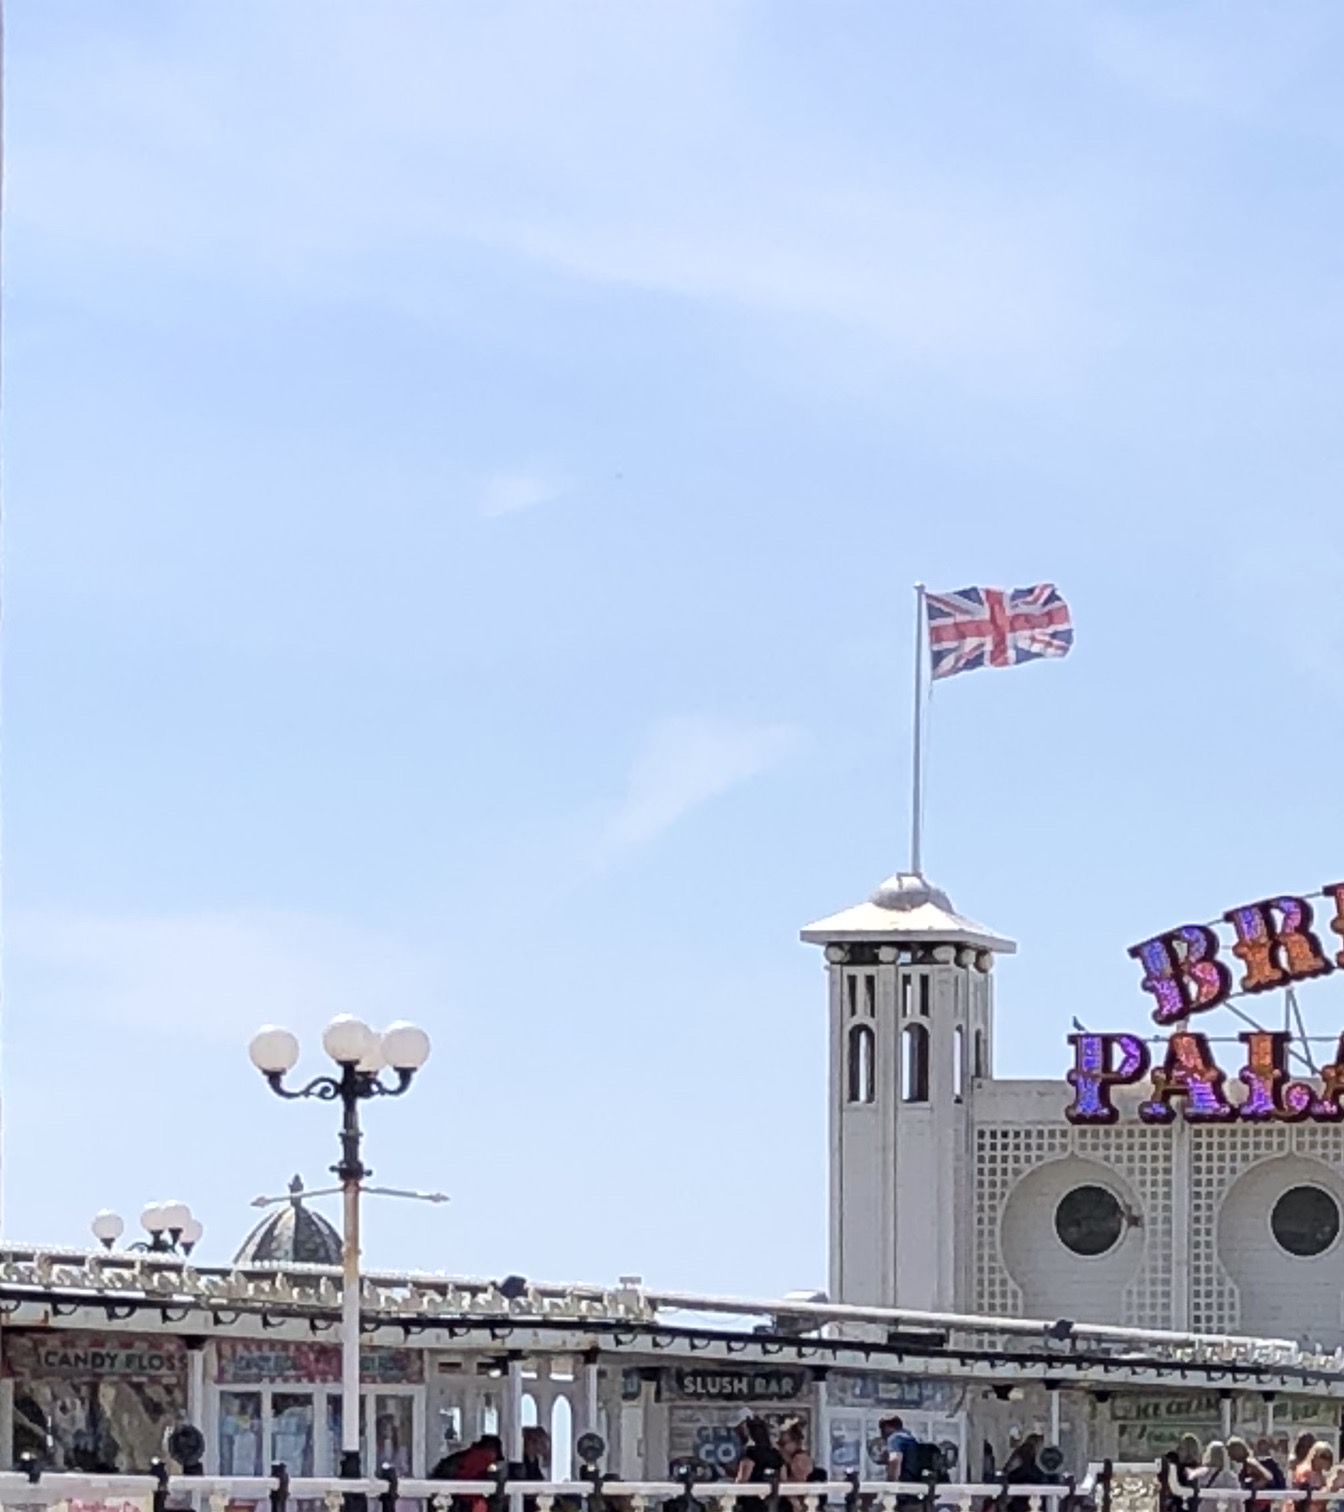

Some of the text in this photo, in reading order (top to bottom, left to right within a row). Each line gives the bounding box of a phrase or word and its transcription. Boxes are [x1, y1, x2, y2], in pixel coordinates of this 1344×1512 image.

[44, 1351, 188, 1371] CANDY FLOSS
[683, 1376, 794, 1394] SLUSH BAR
